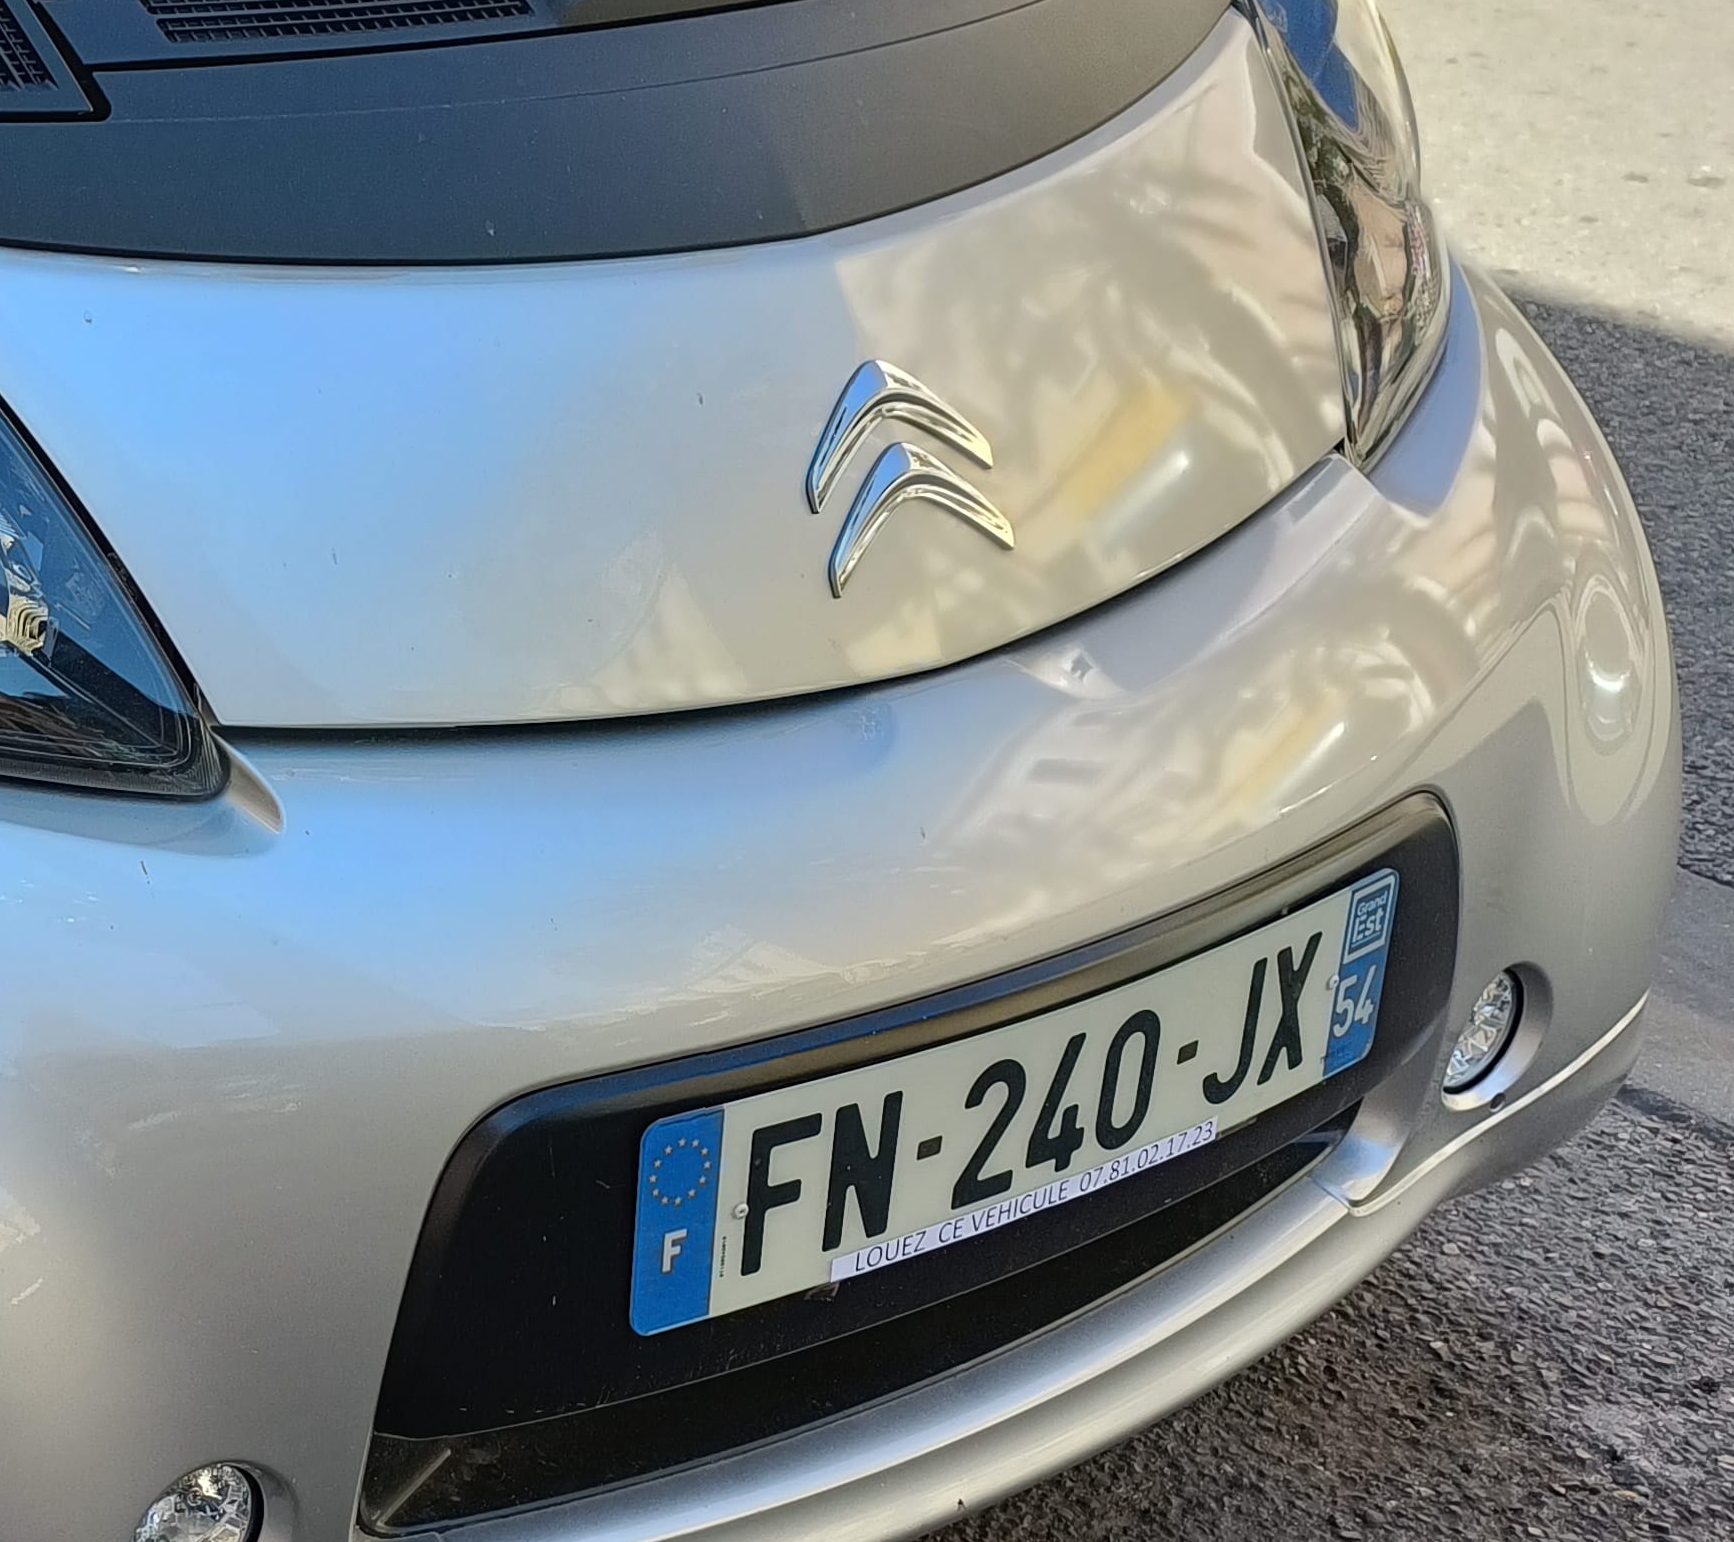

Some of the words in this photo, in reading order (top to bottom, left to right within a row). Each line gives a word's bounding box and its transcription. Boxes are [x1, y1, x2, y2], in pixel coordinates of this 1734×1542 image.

[1352, 907, 1385, 942] Est
[1357, 890, 1388, 916] Grand
[1332, 964, 1377, 1038] 54
[741, 931, 1323, 1276] FN-240-JX
[854, 1232, 927, 1272] LOUEZ
[937, 1217, 965, 1244] CE
[971, 1179, 1070, 1232] VEHICULE
[1079, 1120, 1214, 1192] 07.81.02.17.23
[661, 1228, 688, 1274] F
